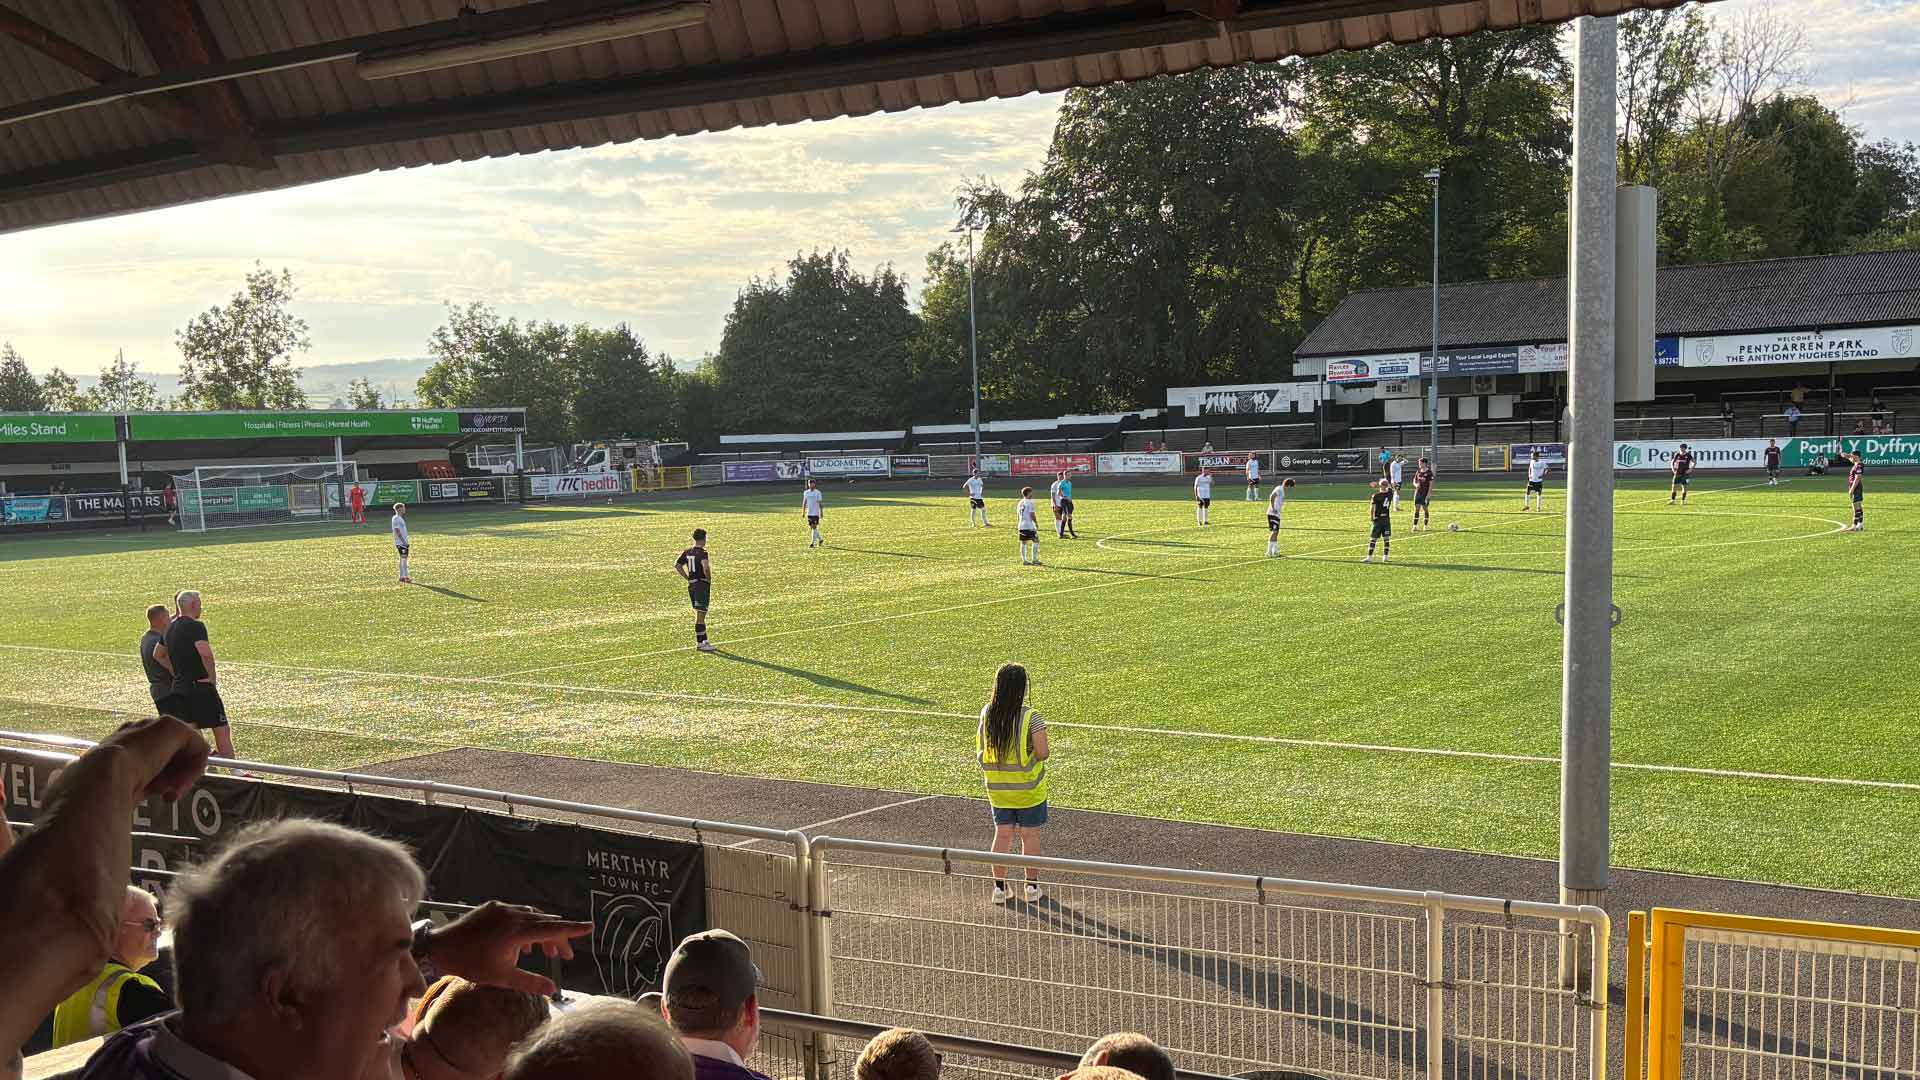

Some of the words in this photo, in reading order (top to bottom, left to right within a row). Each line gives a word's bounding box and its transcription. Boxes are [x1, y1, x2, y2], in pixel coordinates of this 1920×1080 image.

[1739, 341, 1824, 354] PENYDARREN
[1829, 339, 1863, 350] PARK
[1727, 354, 1746, 363] THE
[1747, 352, 1796, 362] ANTHONY
[1798, 350, 1841, 360] HUGHES
[1843, 349, 1878, 358] STAND
[30, 422, 66, 435] Stand
[244, 421, 274, 430] Hospitals
[350, 420, 370, 428] Health
[76, 498, 102, 511] THE
[104, 495, 161, 509] MATYRS
[1383, 497, 1390, 508] 4
[687, 555, 696, 572] 11
[587, 849, 670, 879] MERTHYR
[601, 873, 640, 892] TOWN
[644, 881, 660, 896] FC
